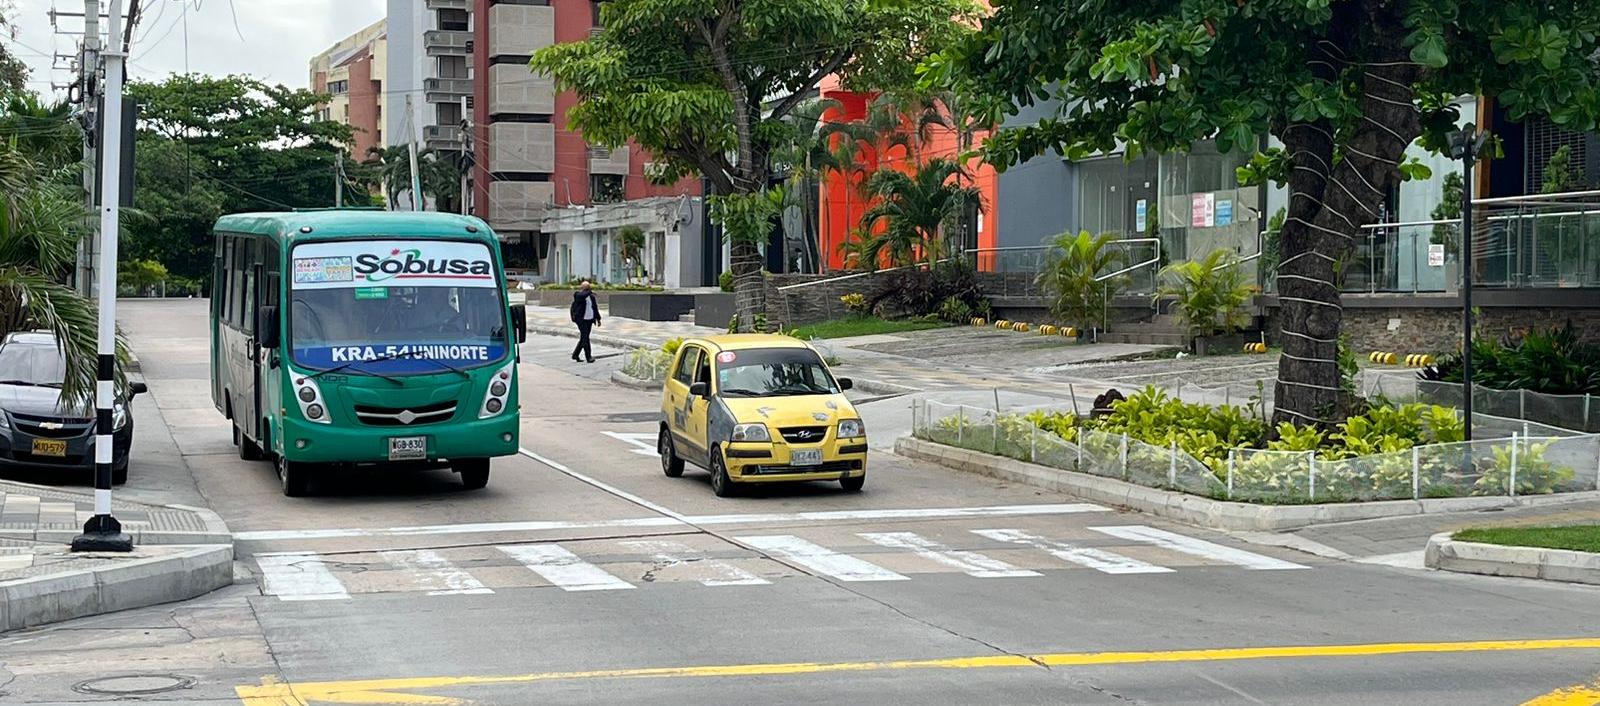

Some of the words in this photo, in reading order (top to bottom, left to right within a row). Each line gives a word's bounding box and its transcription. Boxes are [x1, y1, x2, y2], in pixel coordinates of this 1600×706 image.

[354, 253, 490, 275] Sobusa
[332, 345, 408, 361] KRA-54
[413, 345, 488, 361] UNINORTE
